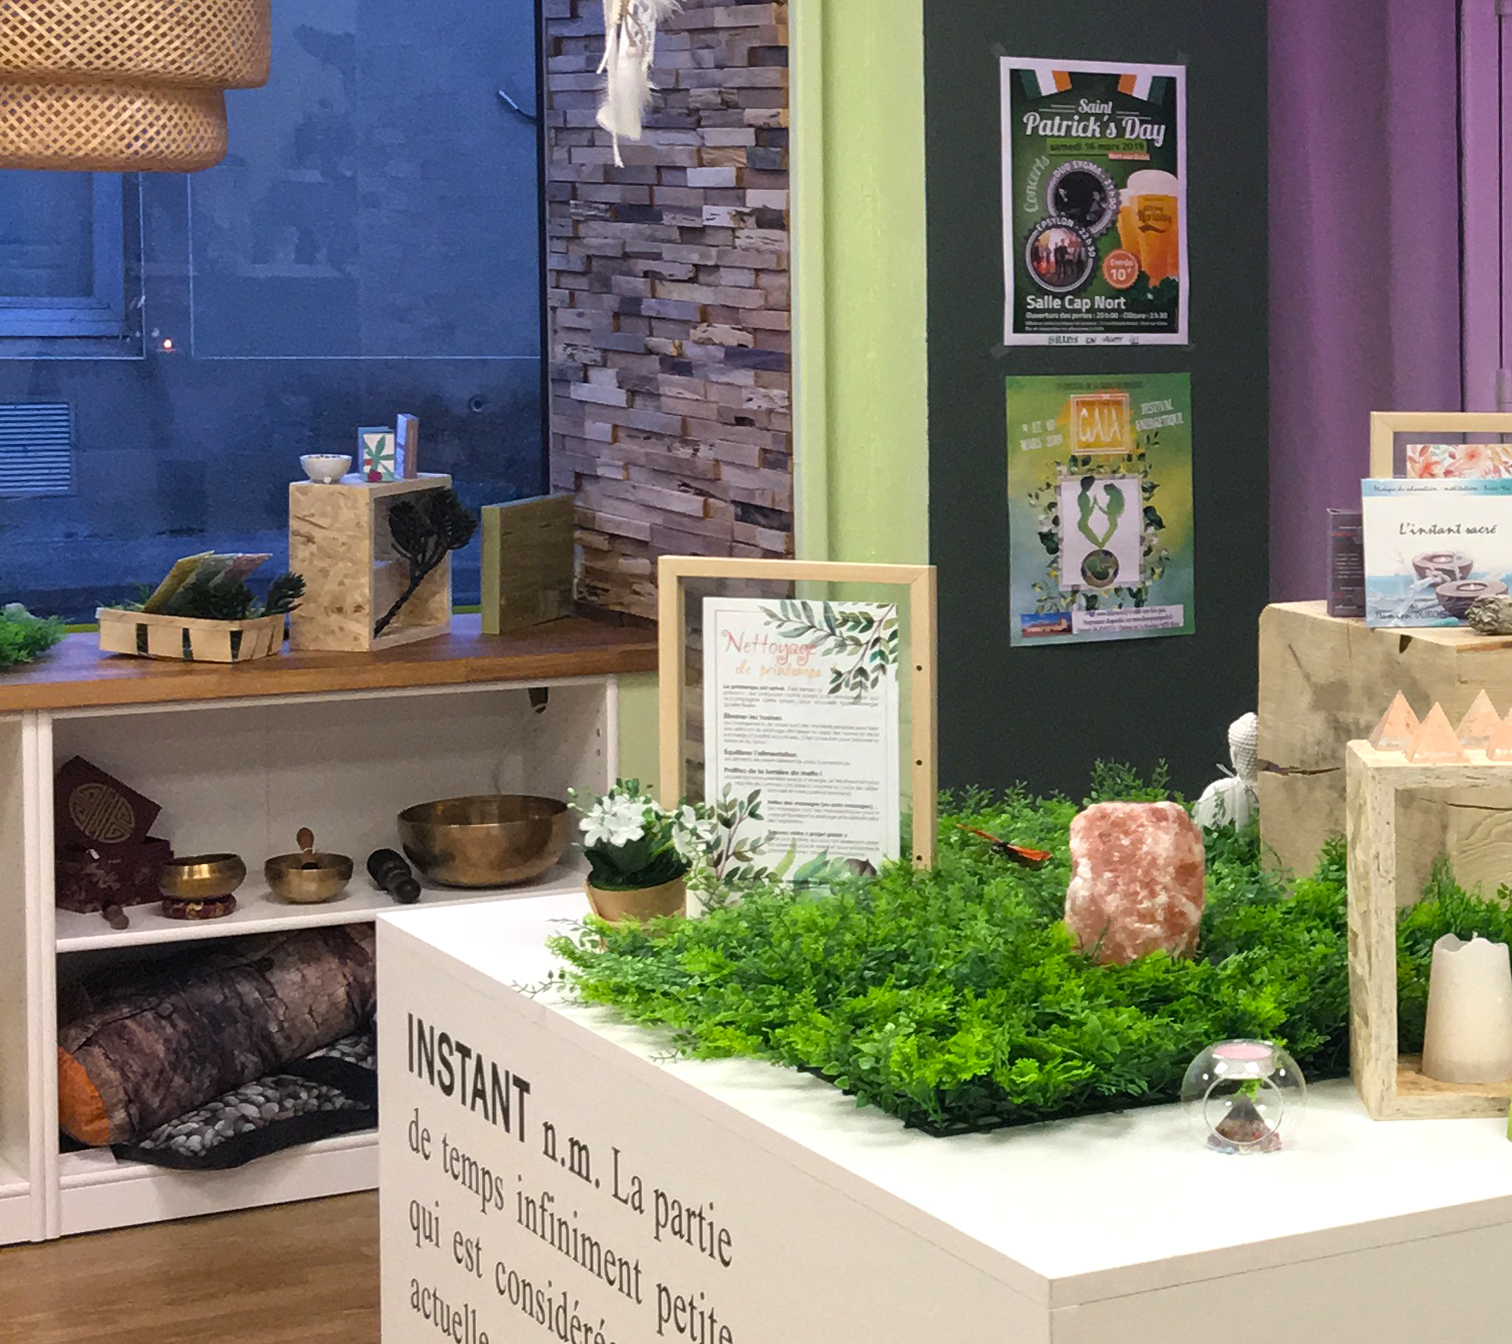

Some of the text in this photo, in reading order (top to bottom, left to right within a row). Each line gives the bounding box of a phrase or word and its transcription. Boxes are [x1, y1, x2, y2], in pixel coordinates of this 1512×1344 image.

[1078, 98, 1113, 114] Saint
[1023, 112, 1166, 147] Patrick's Day
[1085, 142, 1096, 150] 16
[1122, 142, 1144, 151] 2019
[1026, 295, 1126, 312] Salle Cap Nort
[1399, 523, 1498, 536] L'instant sacré
[721, 629, 818, 666] Nettoyage
[735, 659, 751, 675] de
[406, 1012, 734, 1269] INSTANT n.m. La partie
[408, 1107, 432, 1161] de
[441, 1134, 505, 1216] temps
[516, 1174, 643, 1306] infiniment
[409, 1197, 441, 1249] qui
[453, 1227, 483, 1280] est
